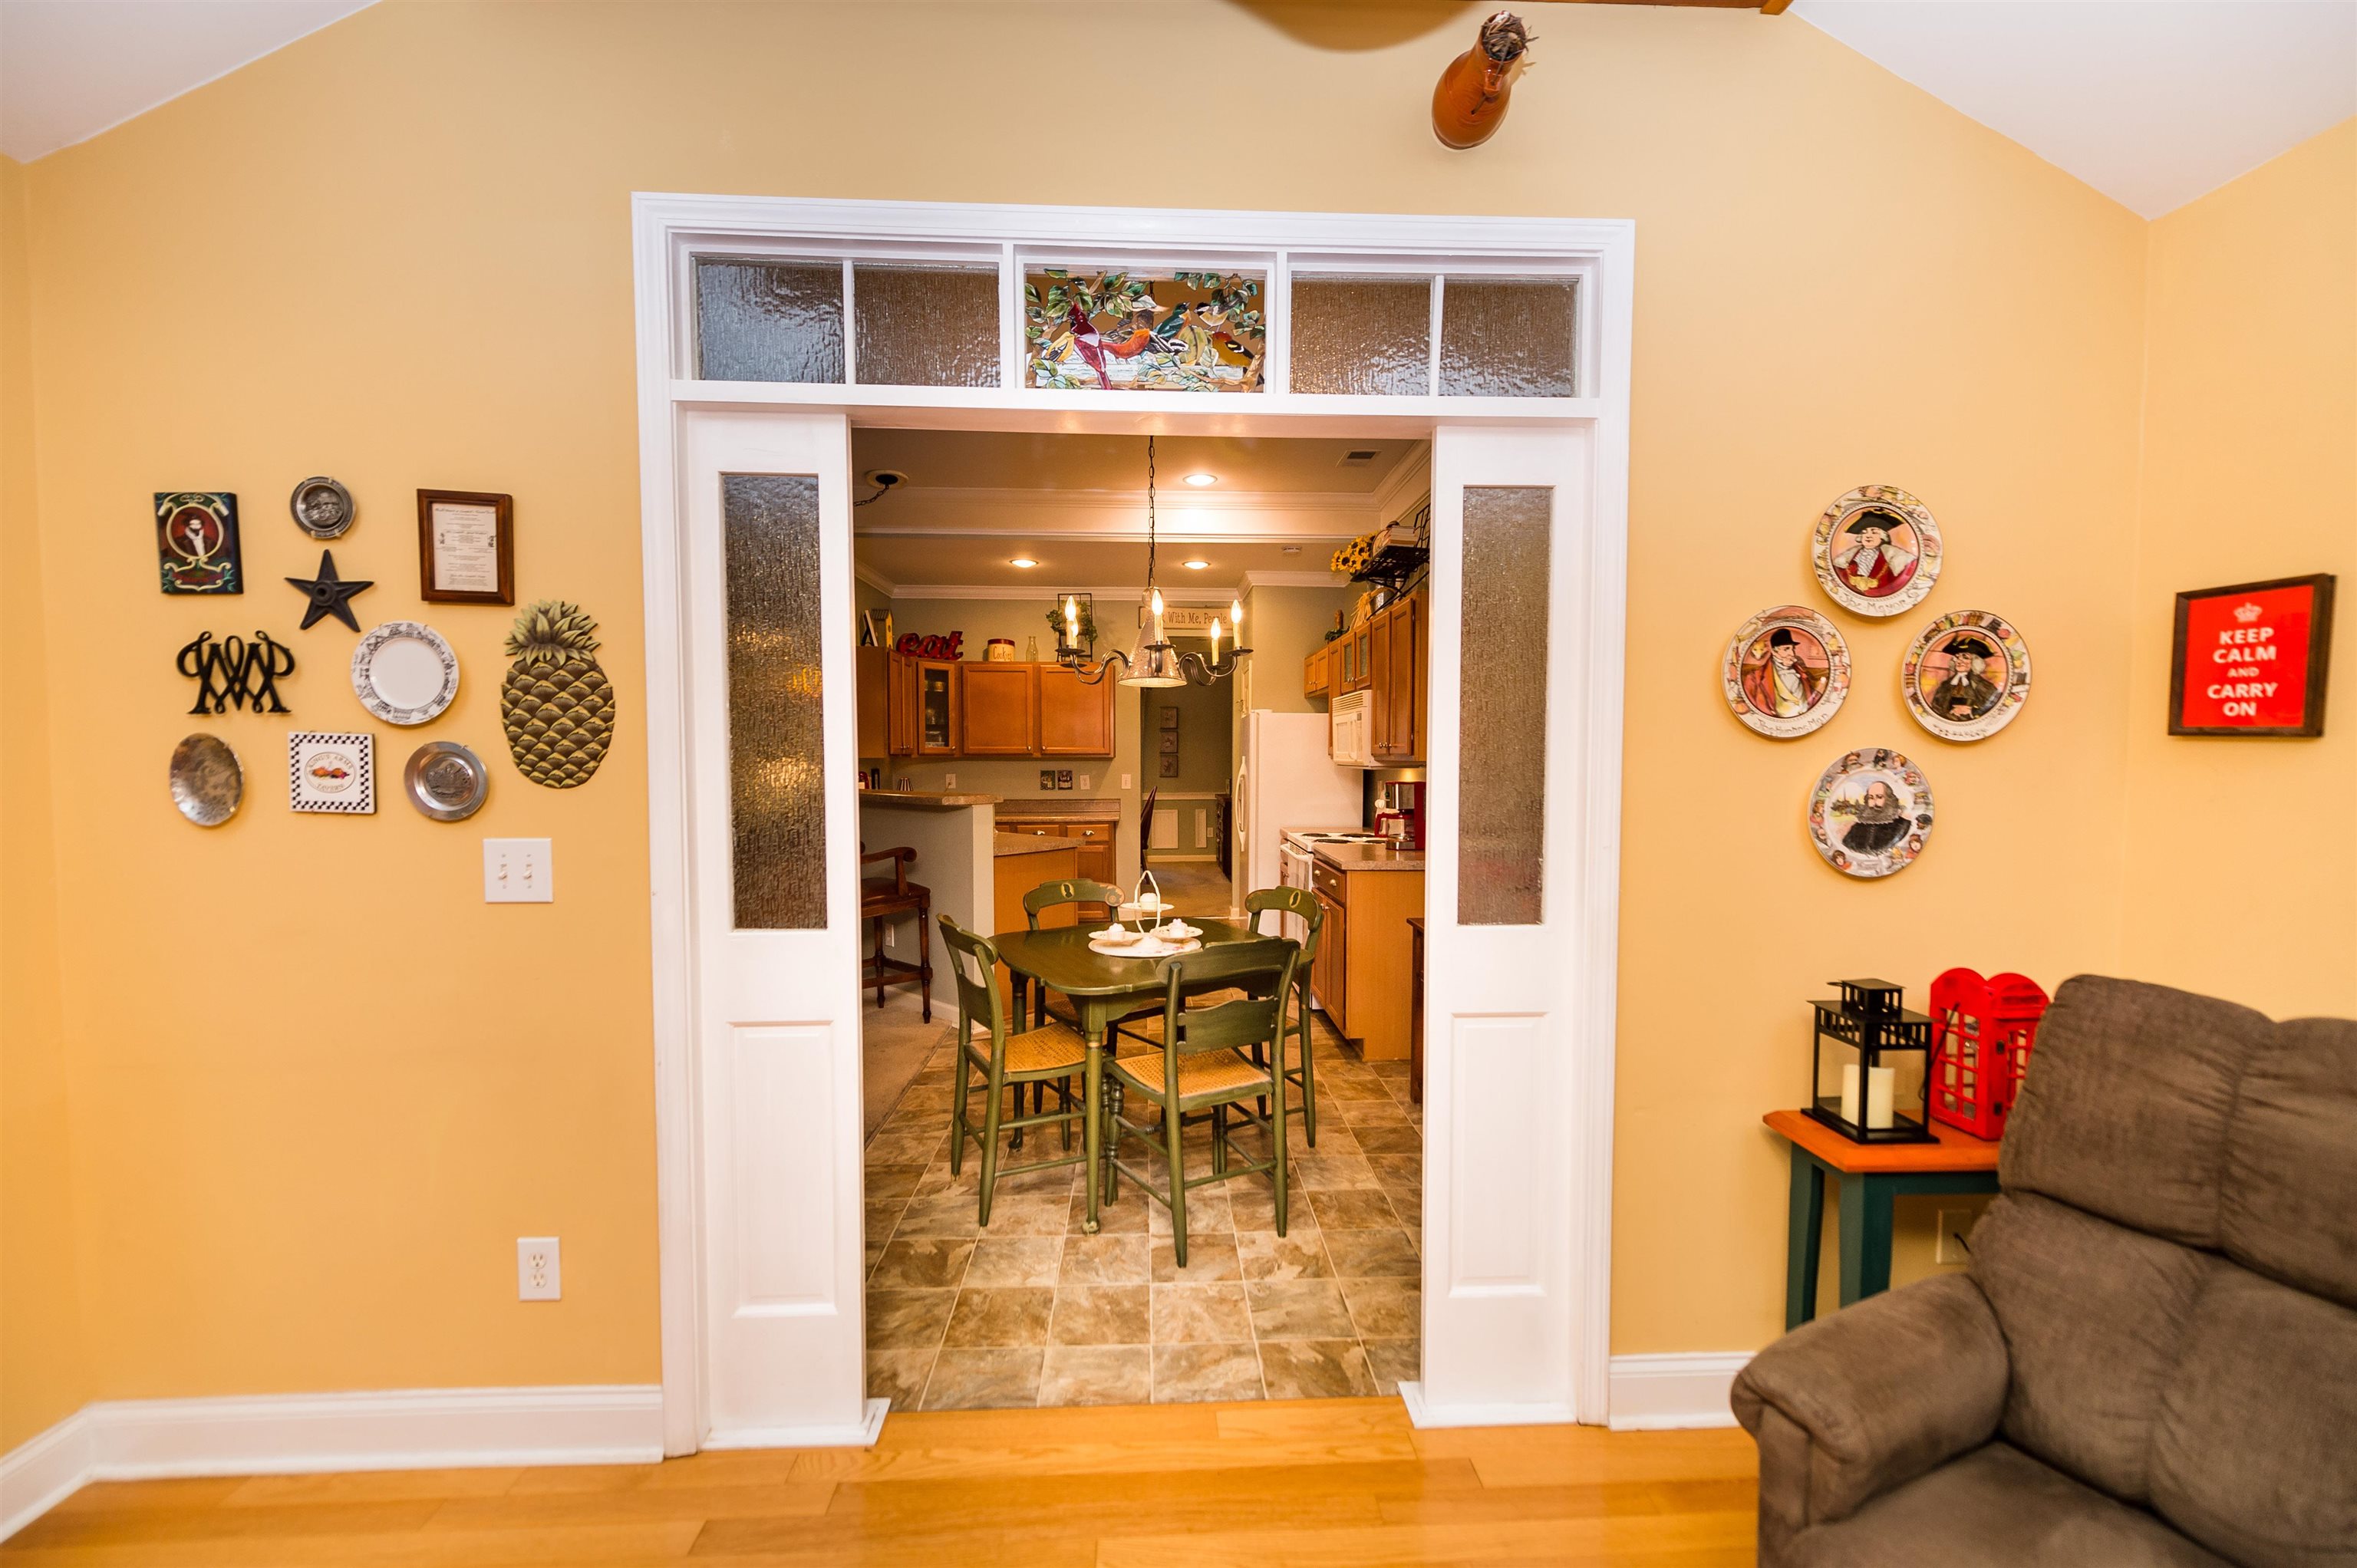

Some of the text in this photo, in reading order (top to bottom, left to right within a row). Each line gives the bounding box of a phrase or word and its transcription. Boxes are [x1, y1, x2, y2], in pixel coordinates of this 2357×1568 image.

[1168, 611, 1186, 624] With
[1188, 612, 1202, 624] Me,
[2219, 627, 2274, 645] KEEP
[895, 631, 964, 660] eat
[2213, 645, 2277, 664] CALM
[2227, 667, 2260, 677] AND
[2207, 682, 2278, 699] CARRY
[2223, 701, 2256, 716] ON
